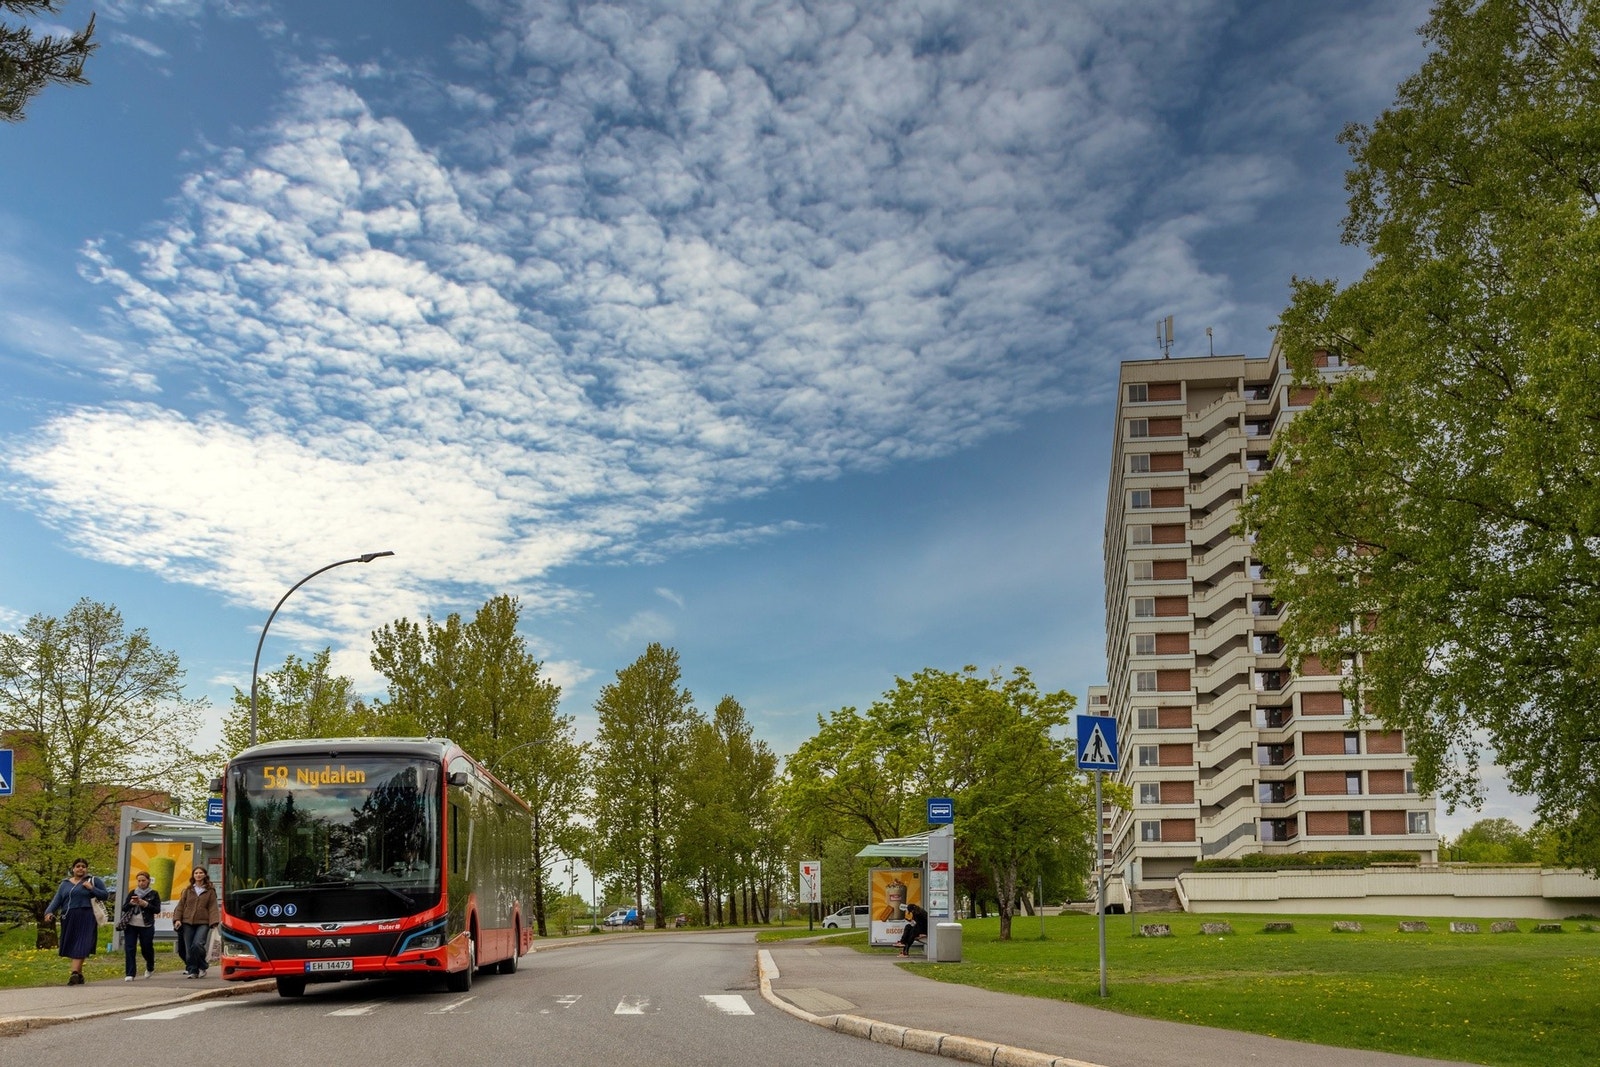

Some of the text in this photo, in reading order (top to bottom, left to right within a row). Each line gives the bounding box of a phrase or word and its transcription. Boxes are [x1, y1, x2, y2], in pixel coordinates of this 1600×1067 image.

[263, 765, 366, 789] 58 Nydalen
[257, 928, 266, 936] 23
[306, 938, 352, 949] MAN
[312, 961, 351, 970] EH 14479
